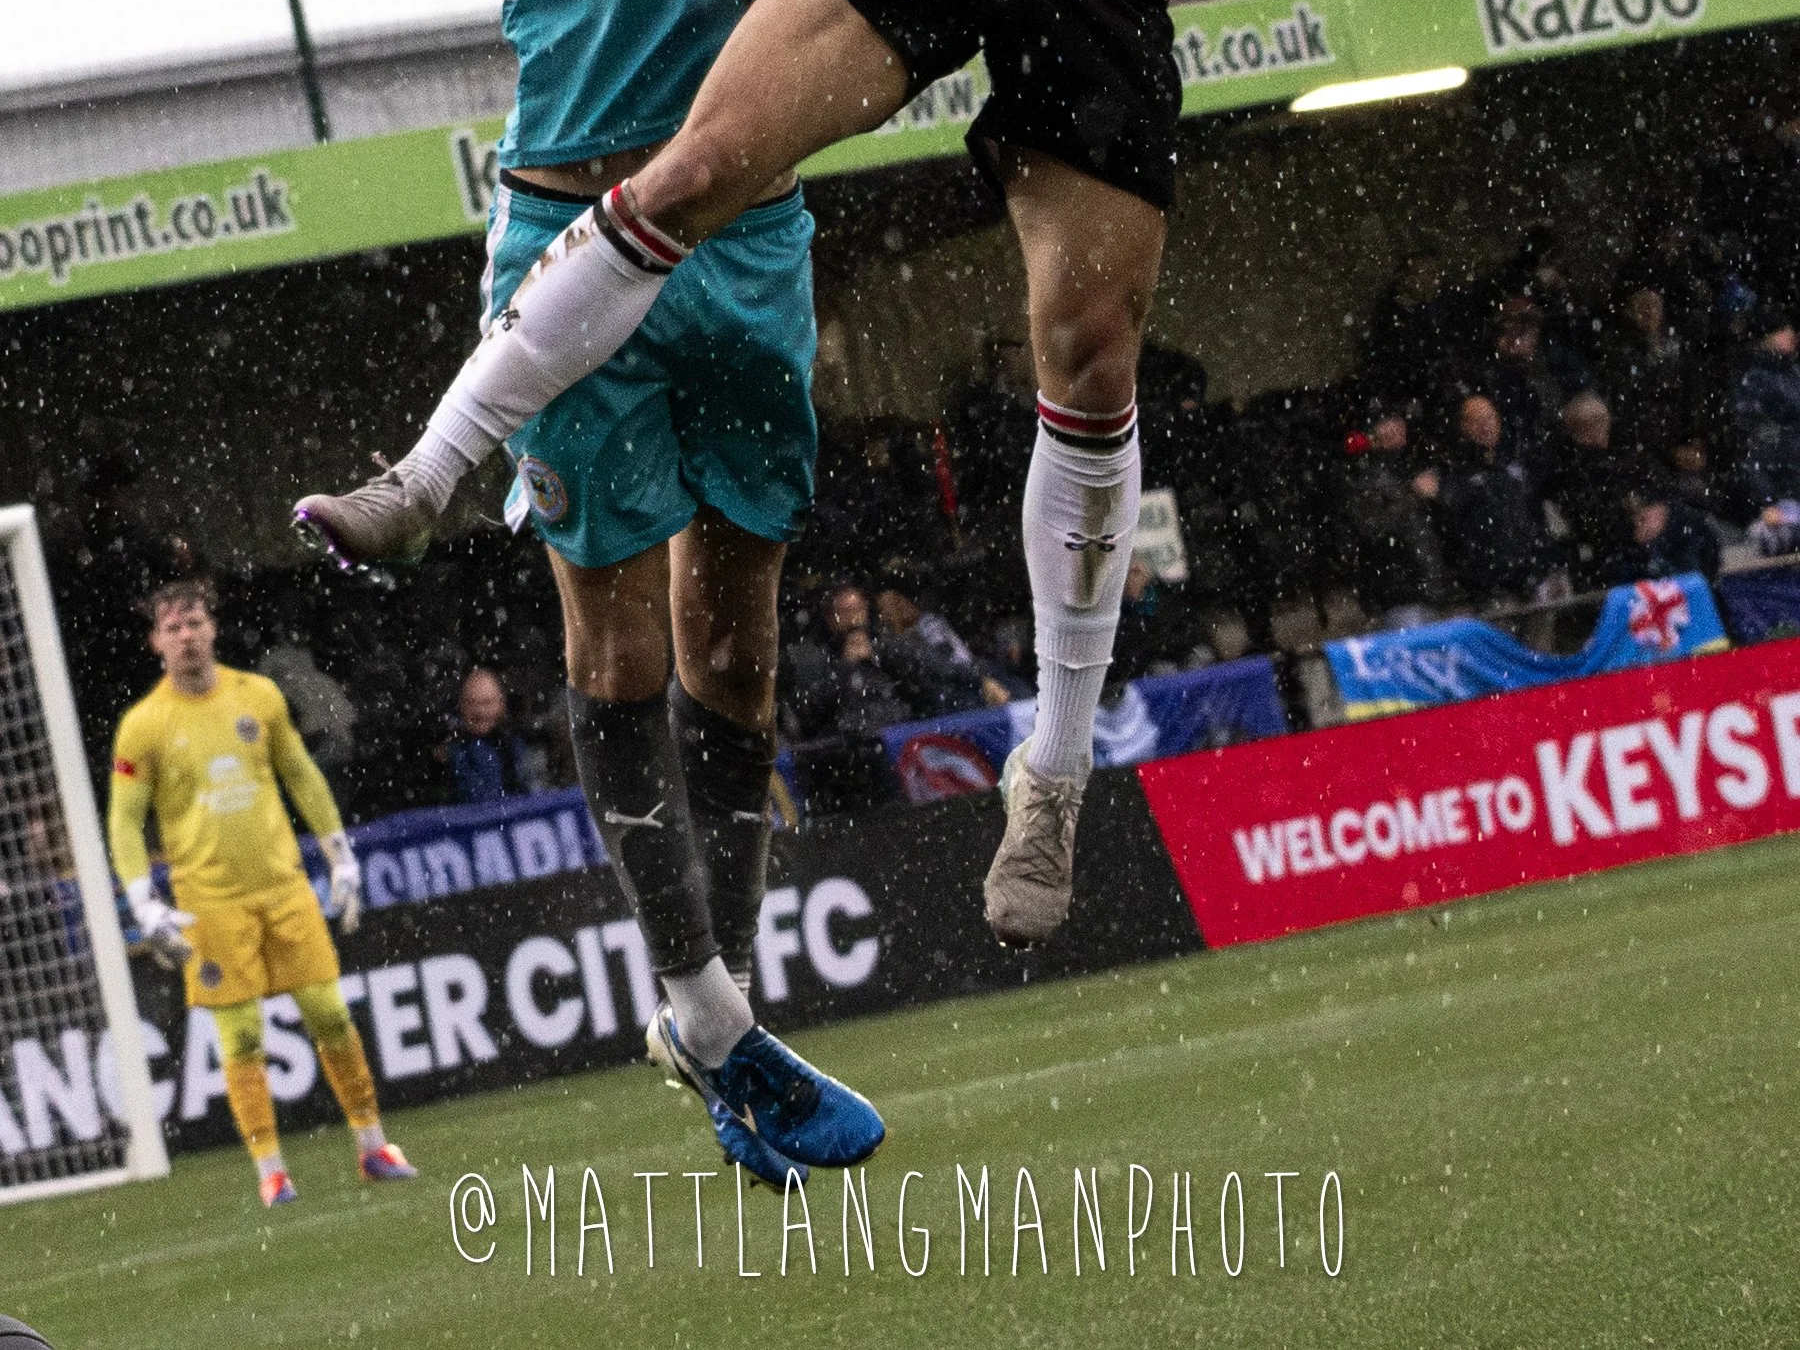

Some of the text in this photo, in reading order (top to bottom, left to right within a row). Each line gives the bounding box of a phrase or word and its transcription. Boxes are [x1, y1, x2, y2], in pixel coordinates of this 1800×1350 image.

[1231, 785, 1470, 884] WELCOME
[1465, 774, 1536, 838] TO
[1534, 701, 1770, 847] KEYS
[505, 918, 660, 1049] CIT
[754, 876, 880, 1003] FC
